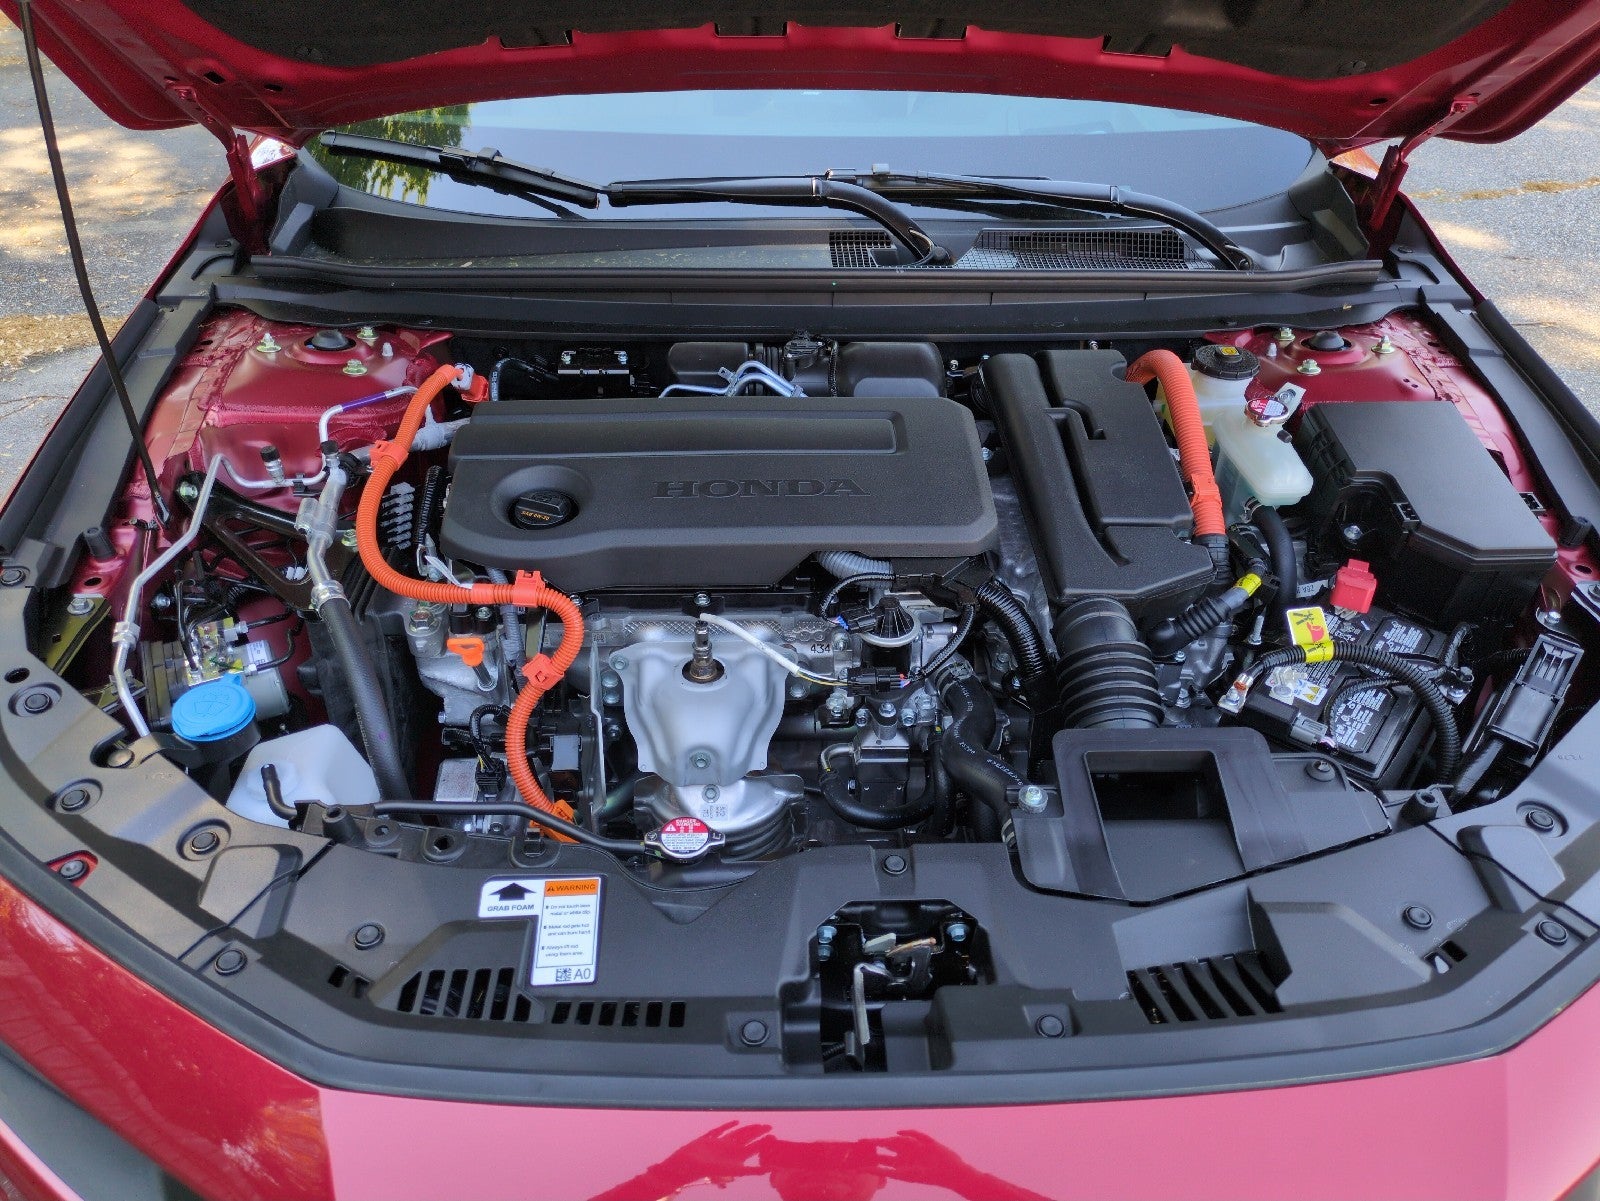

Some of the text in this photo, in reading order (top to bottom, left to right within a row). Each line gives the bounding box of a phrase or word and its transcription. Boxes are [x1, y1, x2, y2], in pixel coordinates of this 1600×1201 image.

[653, 479, 870, 498] HONDA
[811, 643, 831, 654] 434
[556, 884, 596, 892] WARNING
